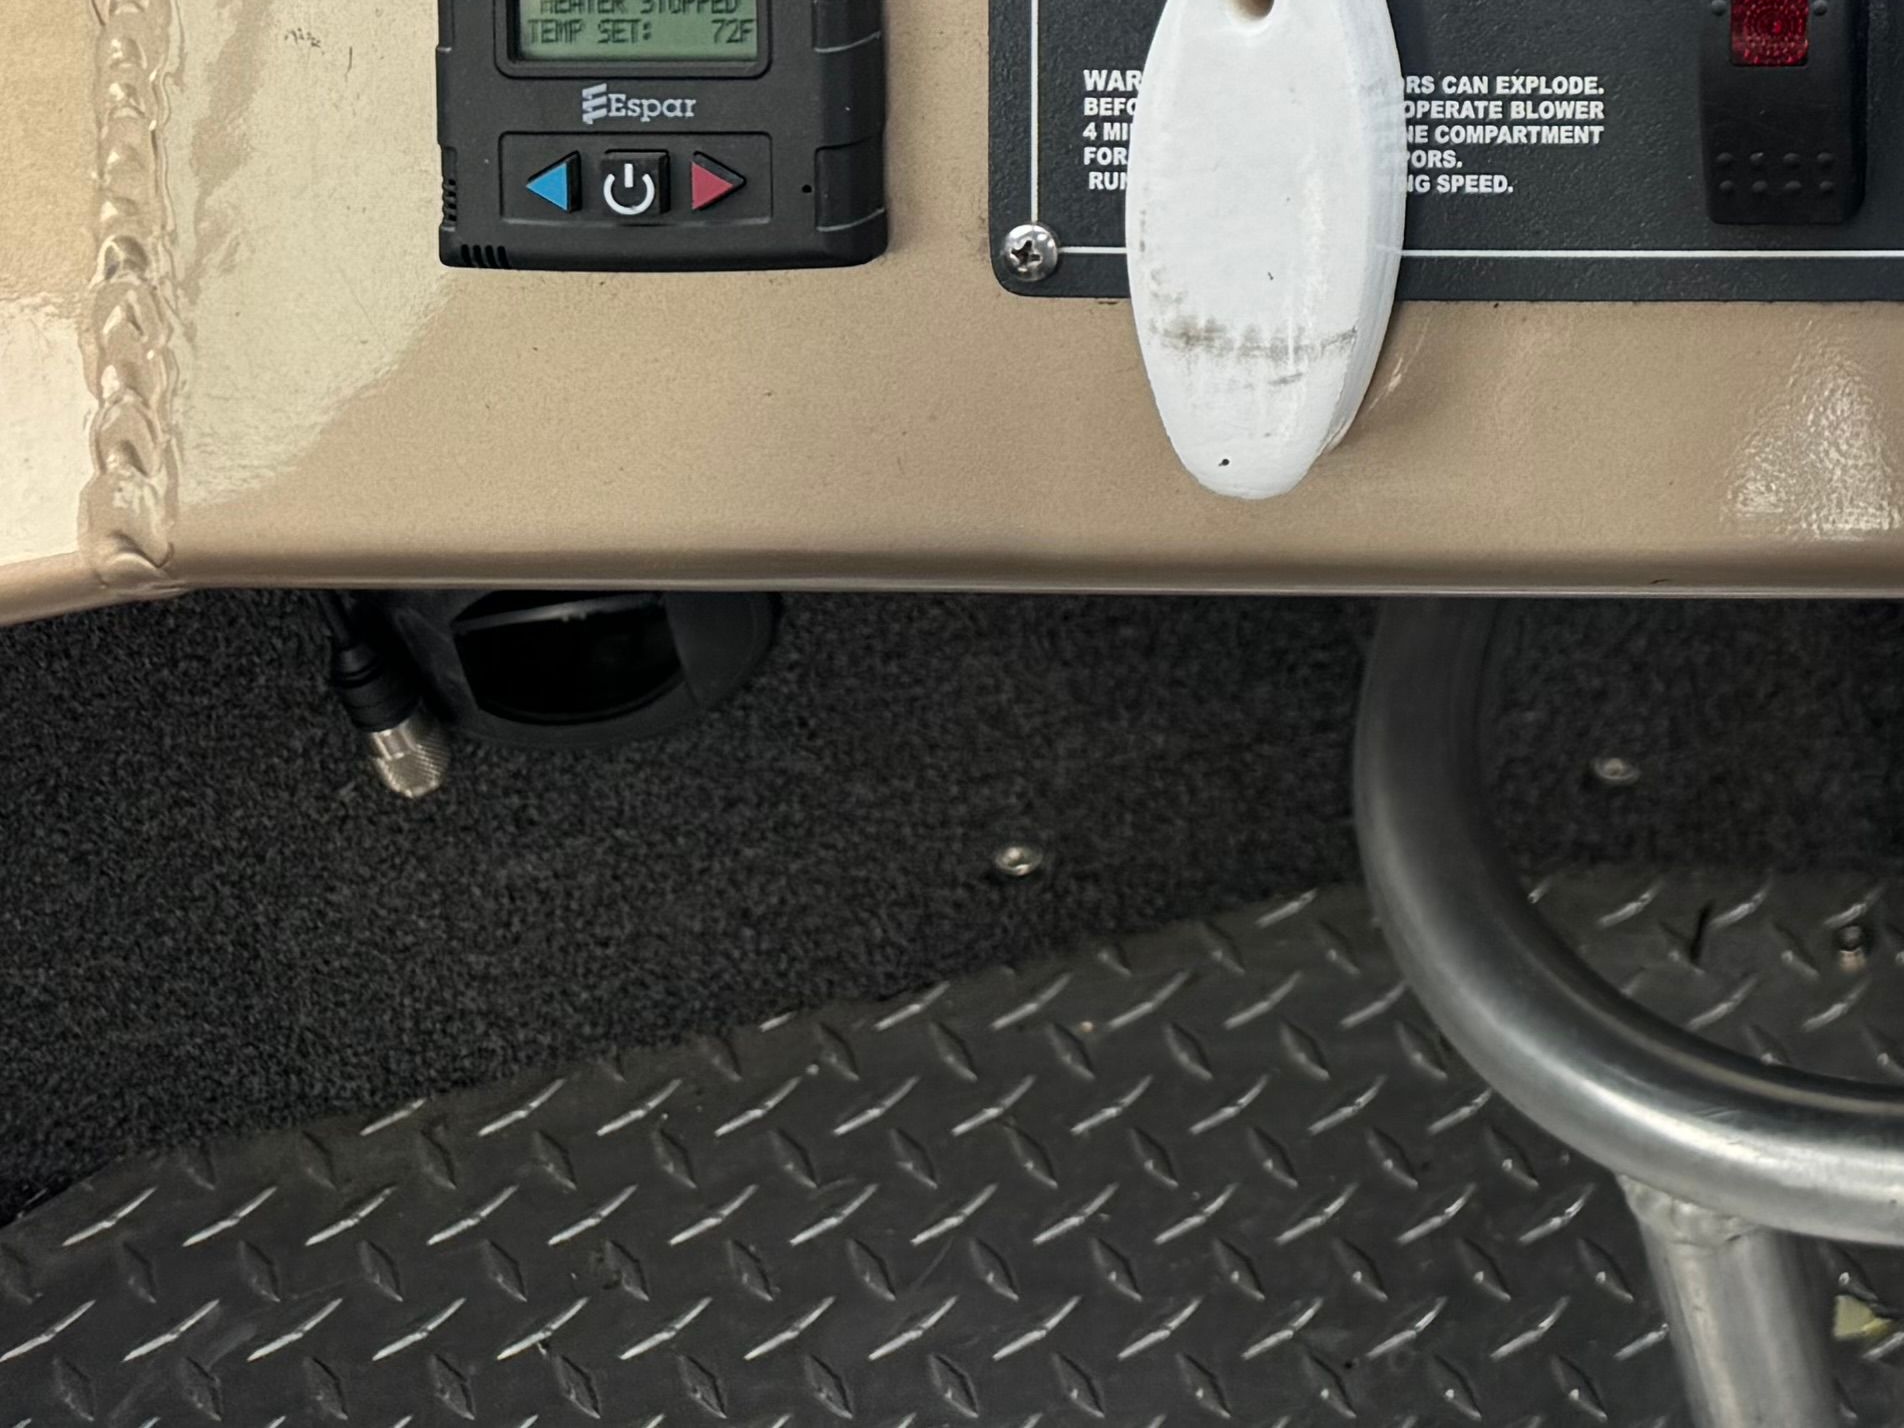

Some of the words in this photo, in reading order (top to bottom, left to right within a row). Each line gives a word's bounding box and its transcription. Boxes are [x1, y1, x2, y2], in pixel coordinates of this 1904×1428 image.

[527, 18, 584, 44] TEMP
[598, 18, 652, 44] SET:
[711, 18, 755, 44] 72F
[1441, 76, 1489, 94] CAN
[1496, 76, 1605, 95] EXPLODE.
[608, 94, 696, 122] Espar
[1403, 101, 1503, 119] OPERATE
[1510, 101, 1605, 120] BLOWER
[1082, 122, 1098, 140] 4
[1434, 125, 1605, 144] COMPARTMENT
[1084, 146, 1129, 165] FOR
[1436, 175, 1514, 193] SPEED.
